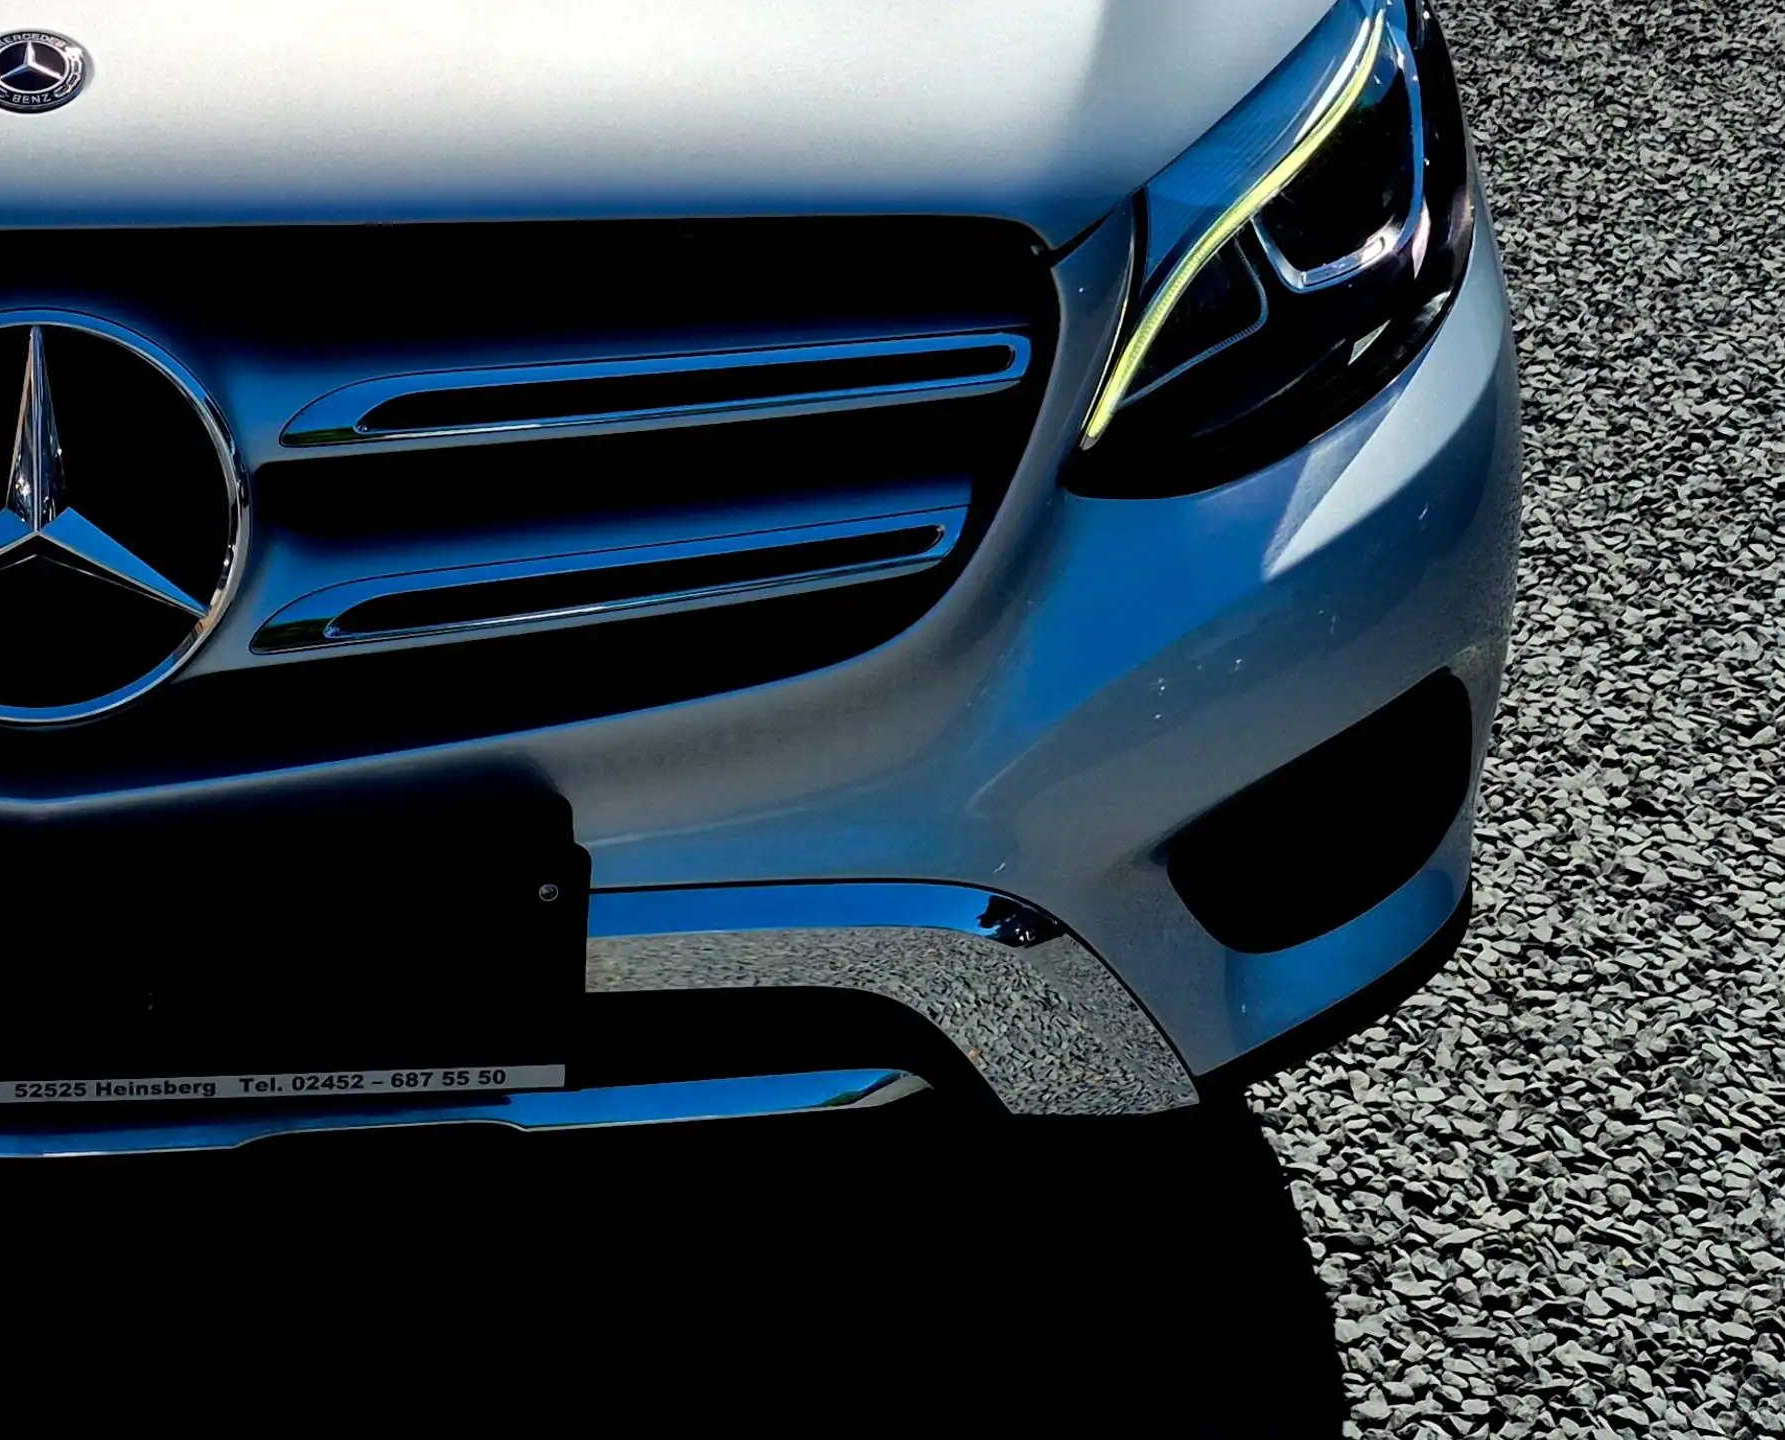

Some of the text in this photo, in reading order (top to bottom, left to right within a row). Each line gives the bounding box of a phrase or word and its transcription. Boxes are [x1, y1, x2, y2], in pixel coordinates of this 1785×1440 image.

[11, 92, 52, 105] BENZ
[14, 1083, 87, 1098] 52525
[95, 1081, 216, 1098] Heinsberg
[238, 1078, 283, 1093] Tel.
[291, 1075, 365, 1092] 02452
[390, 1073, 434, 1088] 687
[441, 1071, 470, 1087] 55
[477, 1069, 507, 1085] 50
